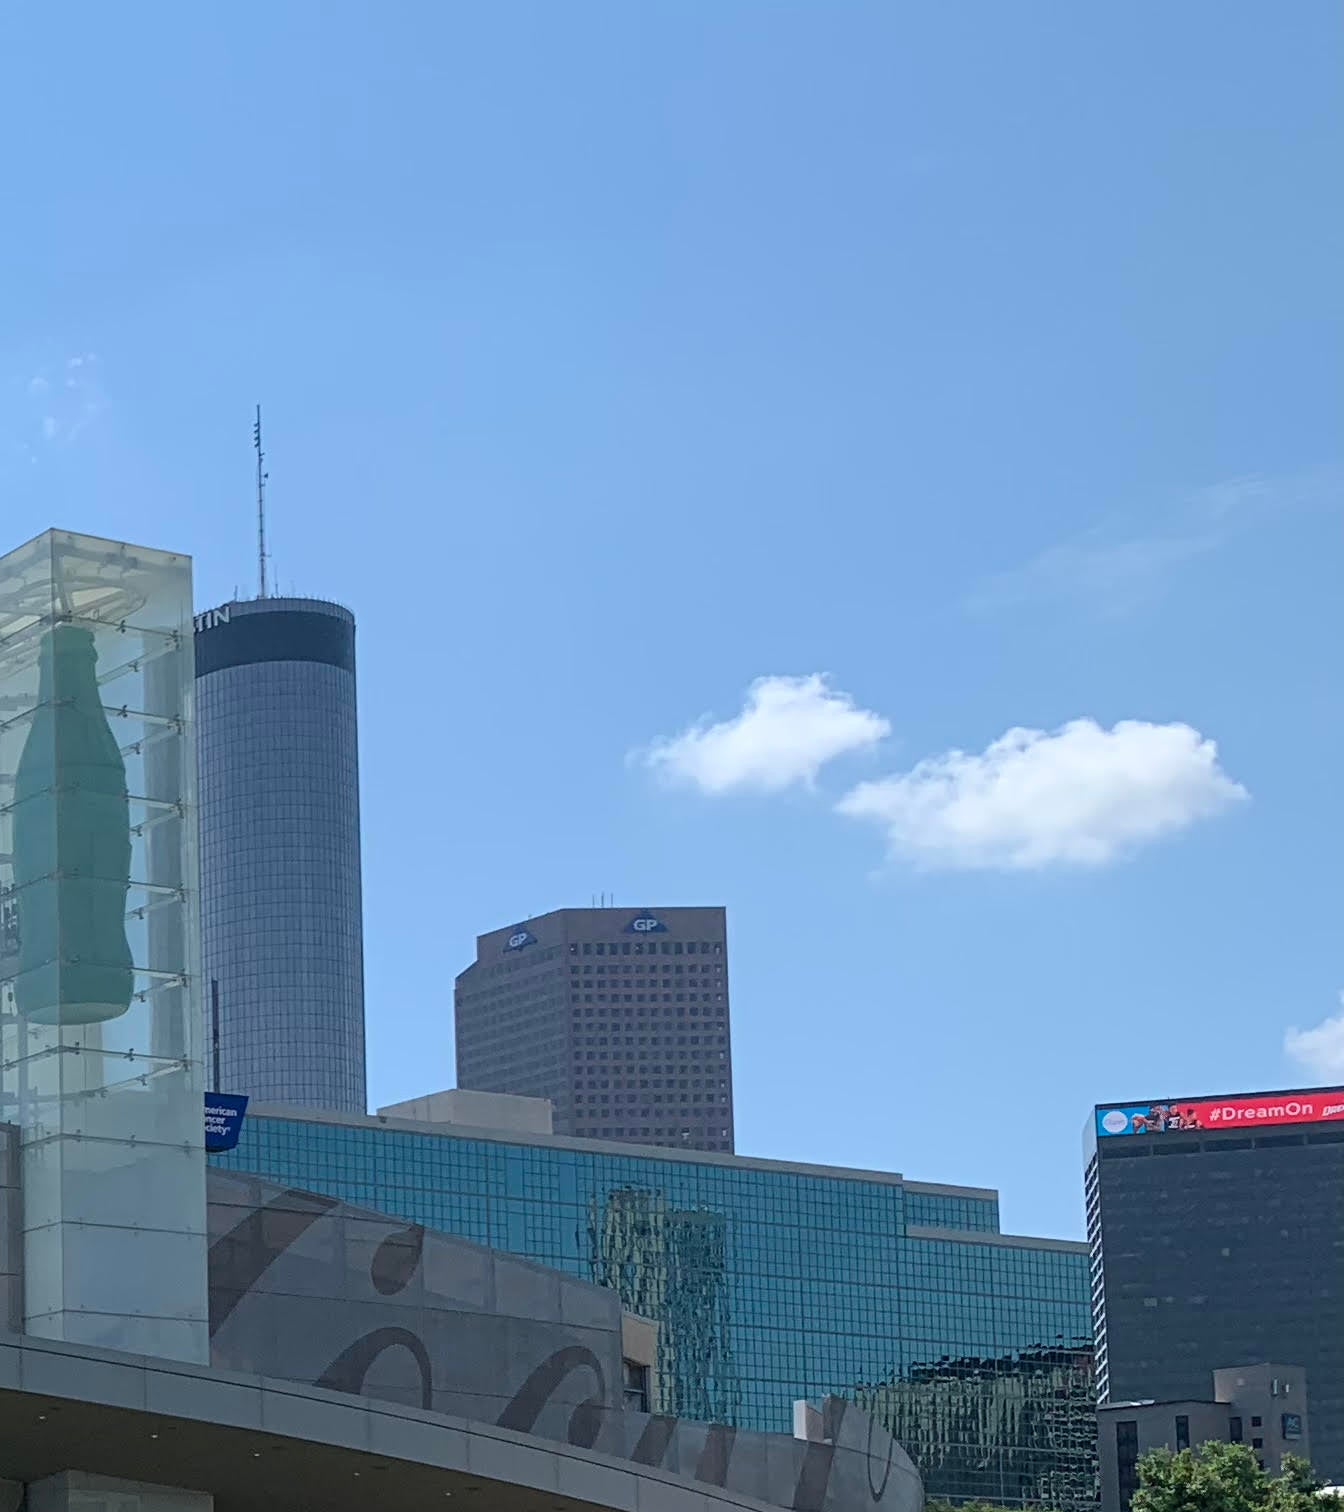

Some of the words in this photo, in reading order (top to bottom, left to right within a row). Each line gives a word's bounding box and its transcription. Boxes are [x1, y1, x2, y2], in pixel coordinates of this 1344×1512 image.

[633, 918, 658, 931] GP
[509, 932, 527, 947] GP
[1209, 1102, 1314, 1121] #DreamOn
